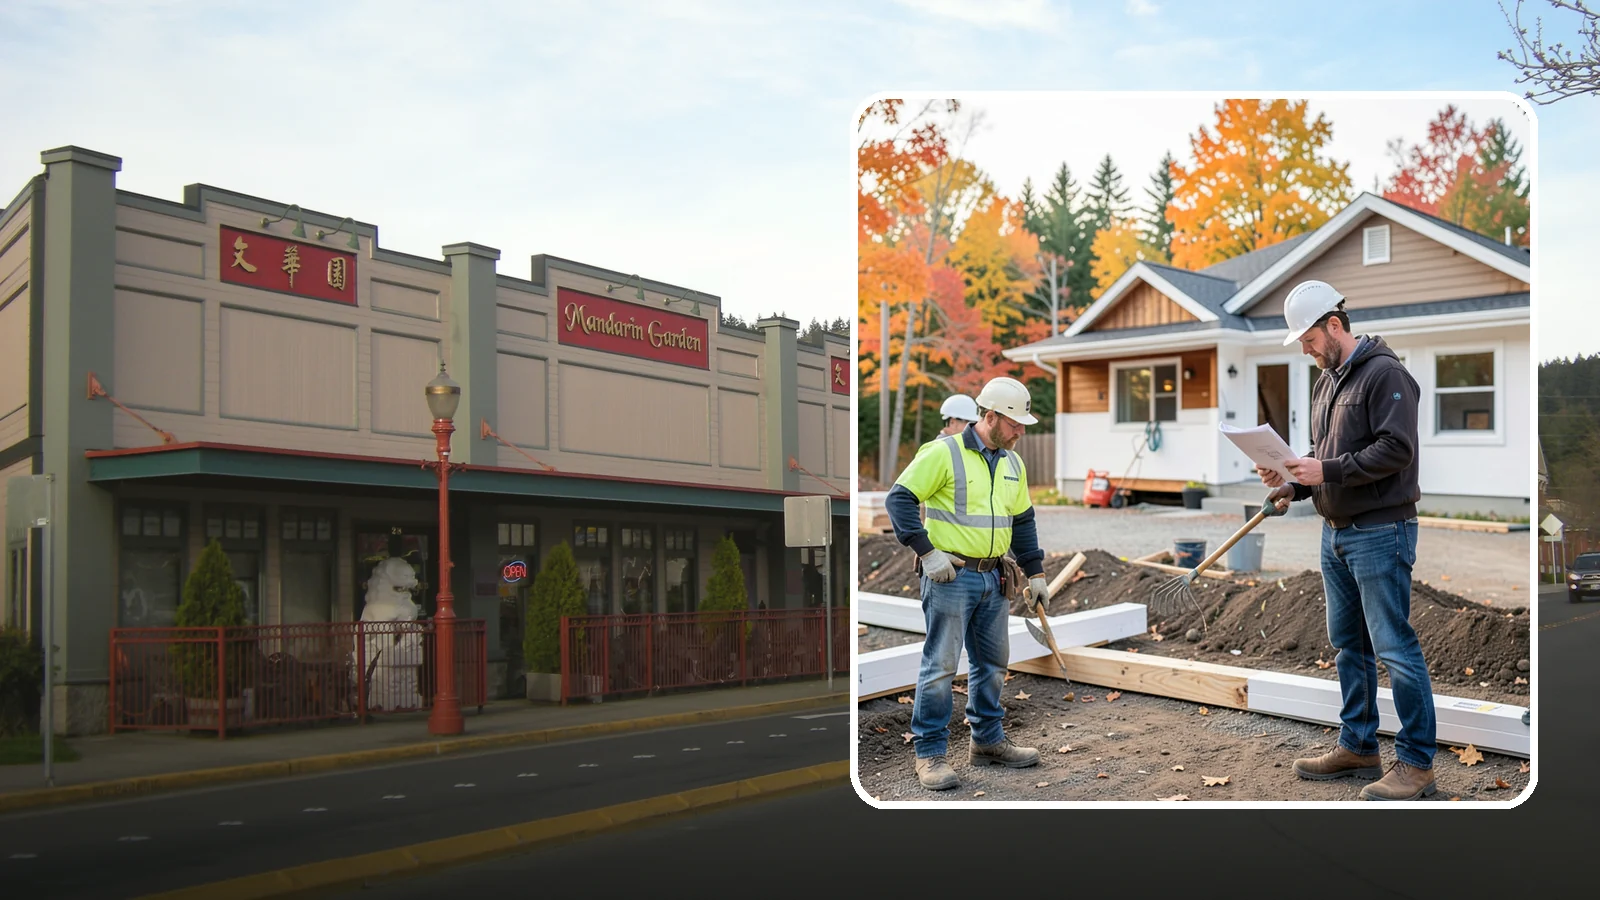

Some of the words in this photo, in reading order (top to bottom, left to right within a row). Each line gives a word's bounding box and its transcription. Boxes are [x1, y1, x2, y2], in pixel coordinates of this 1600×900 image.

[231, 236, 346, 291] 文華園
[564, 302, 644, 341] Mandarin
[648, 320, 701, 352] Garden
[503, 565, 527, 578] OPEN
